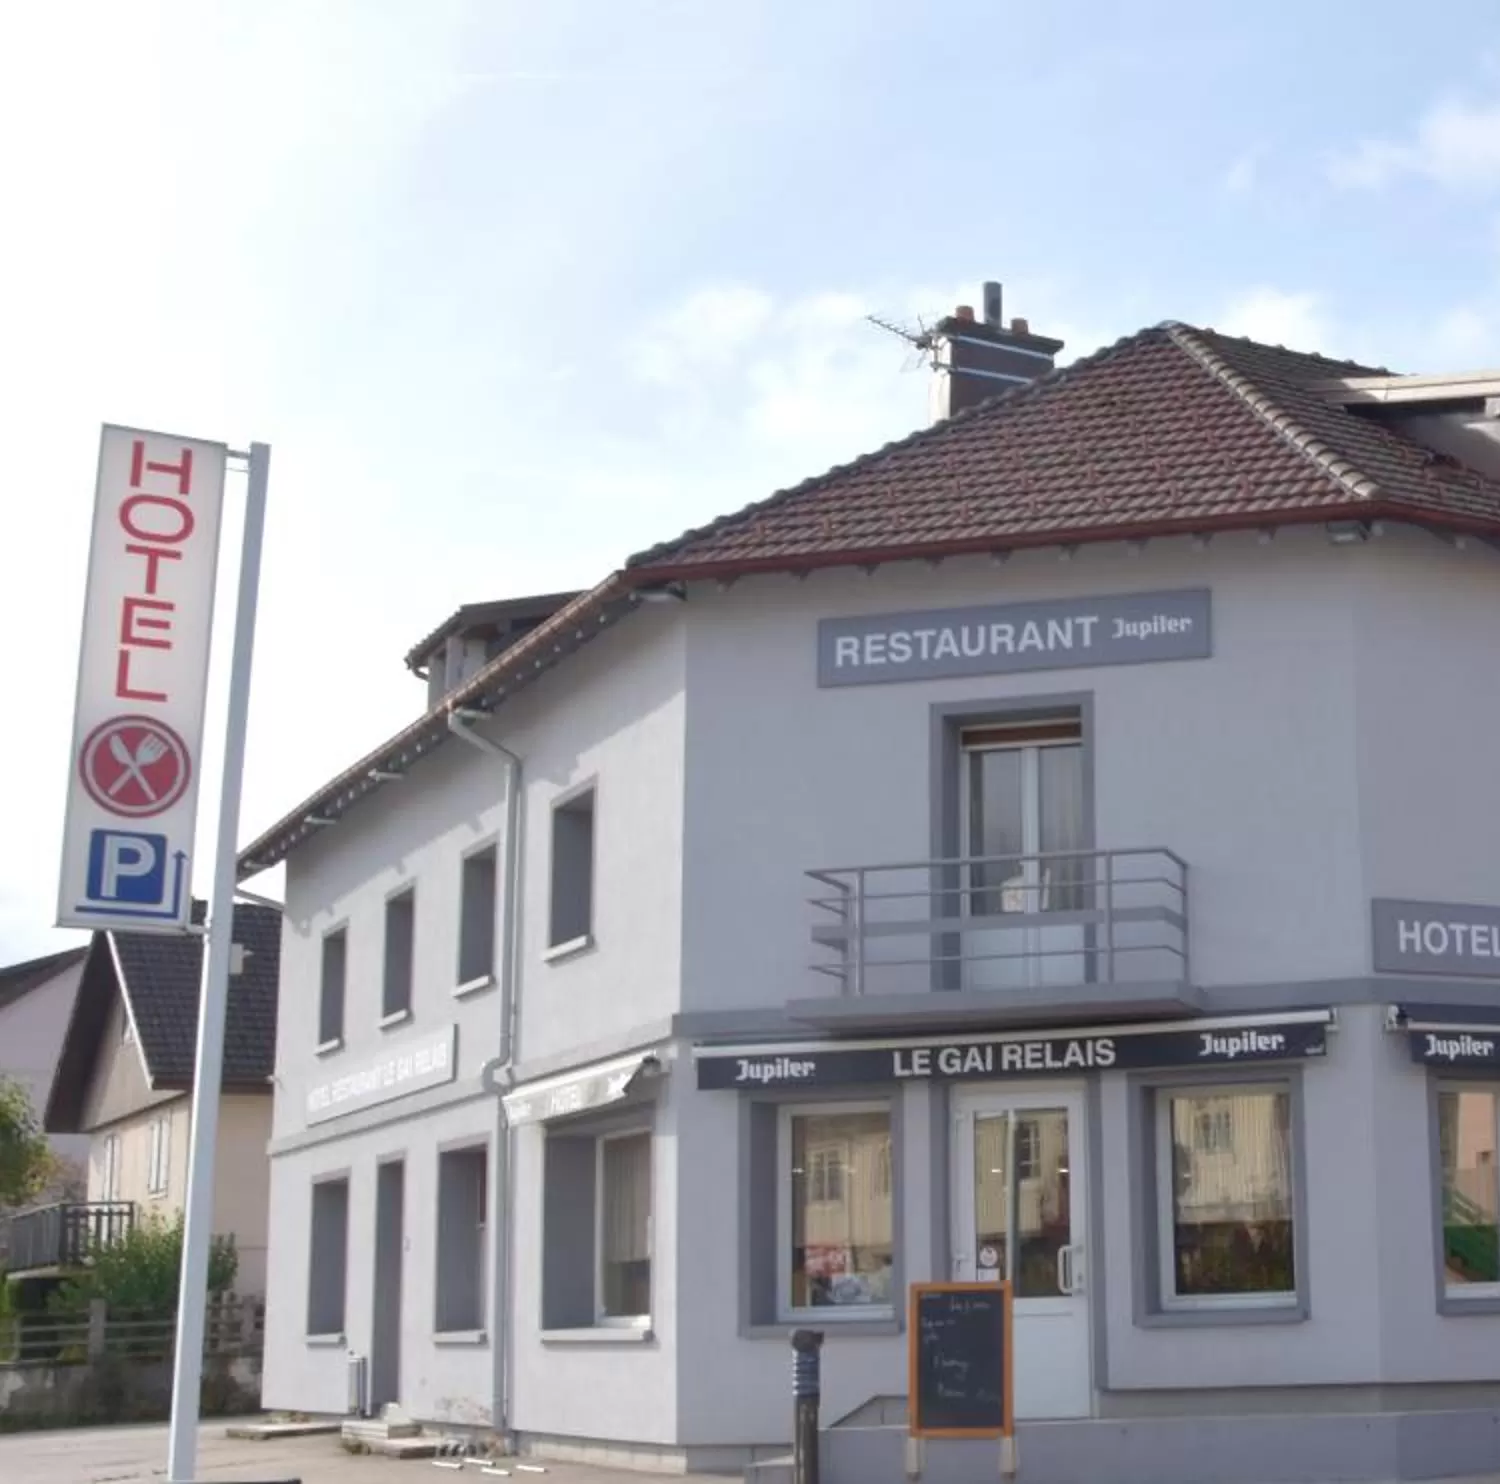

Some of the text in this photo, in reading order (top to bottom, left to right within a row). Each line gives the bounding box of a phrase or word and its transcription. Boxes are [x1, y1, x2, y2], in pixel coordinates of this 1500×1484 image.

[116, 440, 194, 702] HOTEL
[835, 615, 1099, 668] RESTAURANT
[1112, 614, 1193, 641] Jupiler
[101, 834, 156, 899] P
[893, 1037, 1117, 1077] LE GAI RELAIS
[1199, 1031, 1285, 1058] Jupiler
[1424, 1034, 1494, 1059] Jupiler
[735, 1058, 815, 1085] Jupiler
